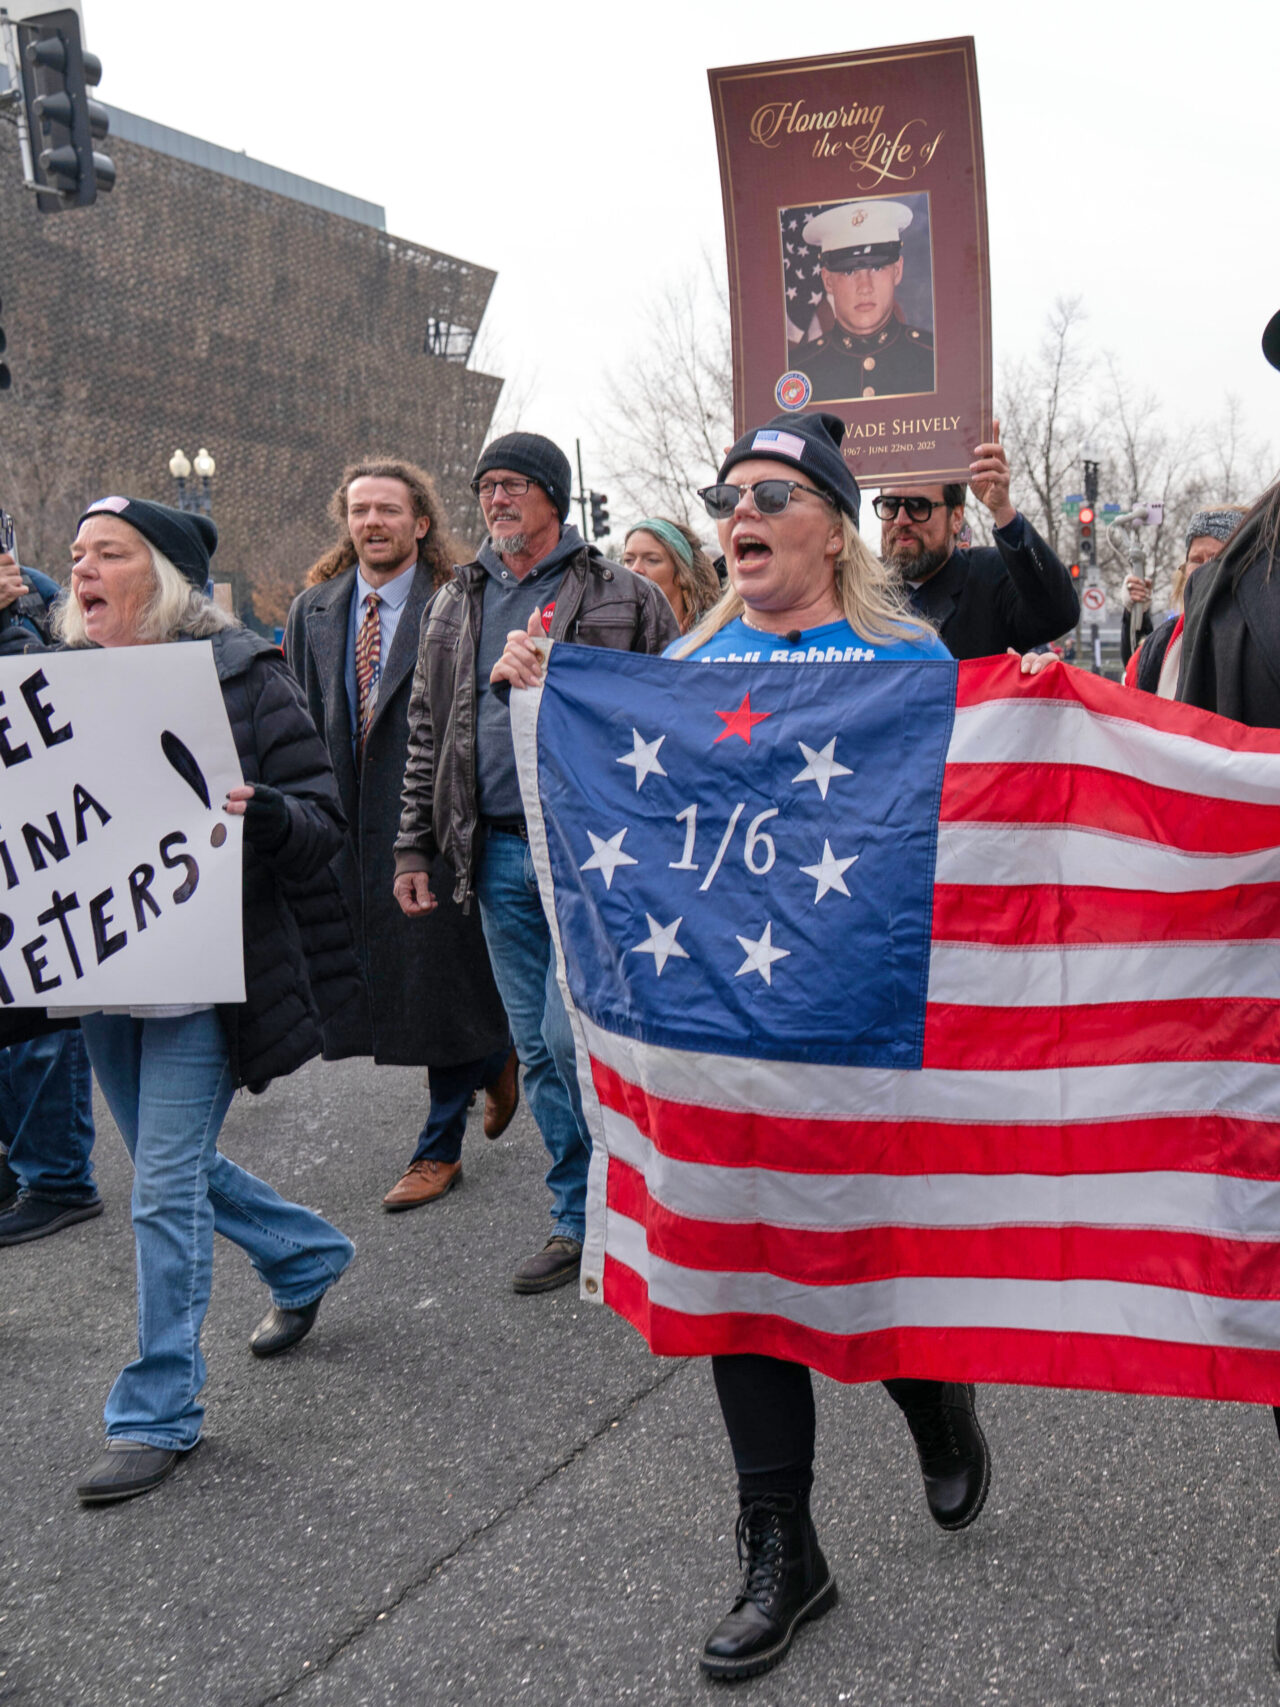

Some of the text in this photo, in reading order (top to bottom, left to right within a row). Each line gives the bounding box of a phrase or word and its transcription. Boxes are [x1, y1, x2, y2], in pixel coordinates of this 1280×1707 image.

[749, 99, 885, 148] Honoring
[812, 118, 945, 190] the Life of
[842, 446, 861, 457] 1967
[868, 445, 888, 457] JUNE
[917, 440, 936, 451] 2025
[892, 415, 961, 436] SHIVELY
[668, 802, 779, 891] 1/6
